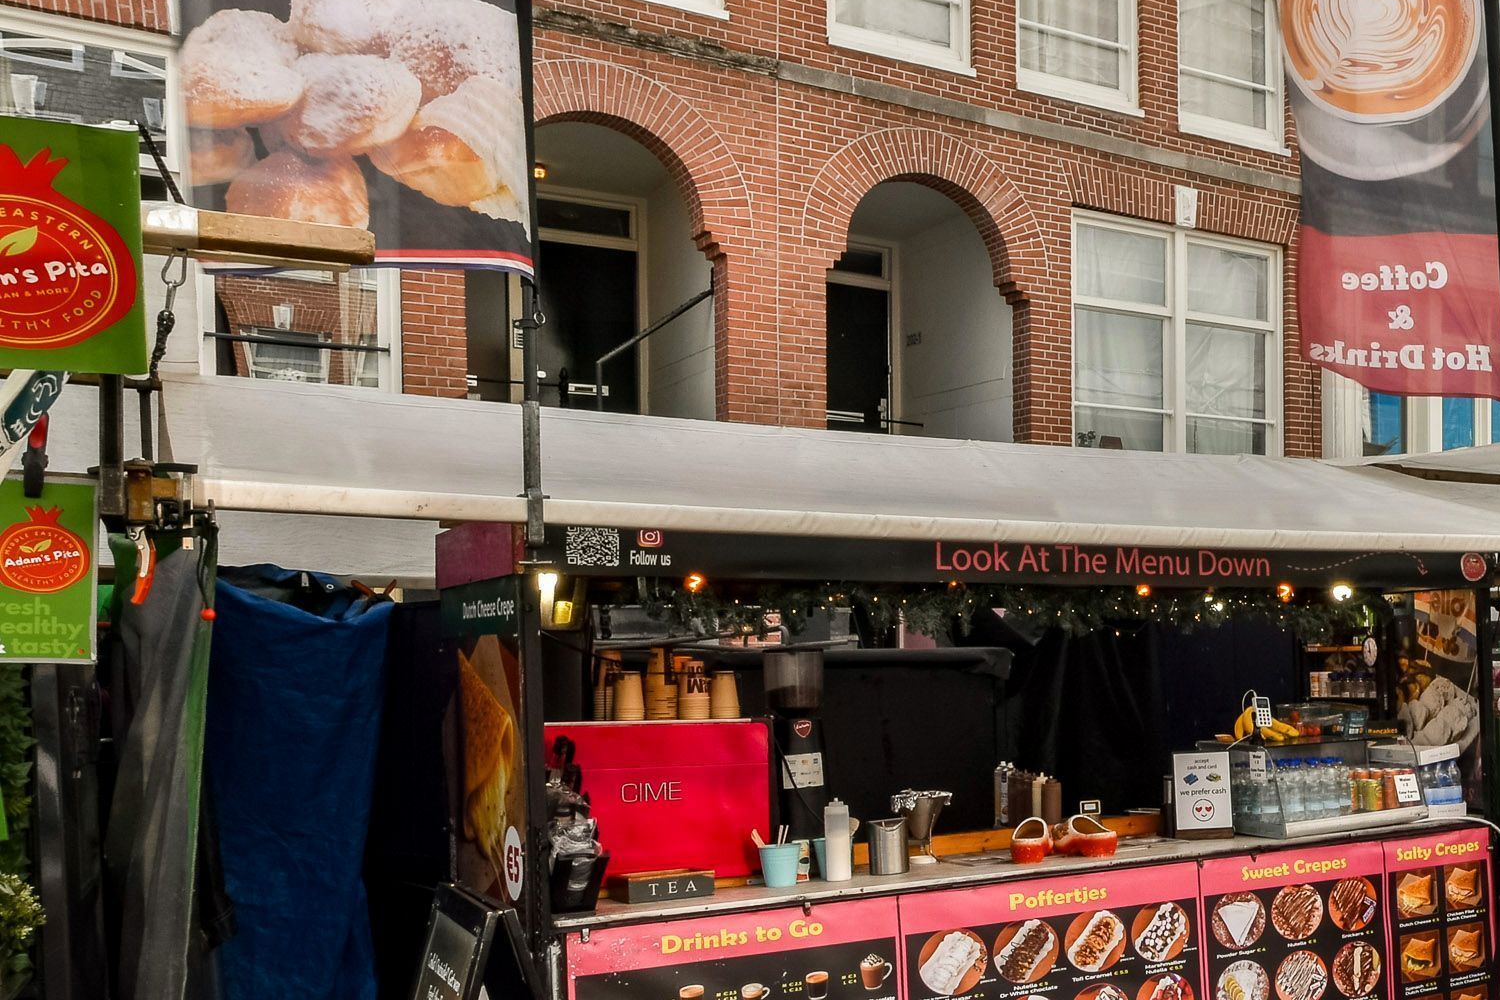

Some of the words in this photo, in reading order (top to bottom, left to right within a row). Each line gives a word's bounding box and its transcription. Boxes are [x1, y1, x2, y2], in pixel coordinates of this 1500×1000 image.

[44, 260, 108, 283] Pita
[4, 553, 51, 568] Adam's
[53, 549, 80, 563] Pita
[630, 550, 657, 567] Follow
[660, 554, 672, 567] us
[935, 541, 1010, 572] Look
[1018, 544, 1050, 573] At
[1055, 545, 1108, 574] The
[1115, 547, 1191, 576] Menu
[1199, 549, 1271, 577] Down
[477, 599, 497, 618] Cheese
[496, 596, 515, 621] Crepe
[621, 781, 683, 803] CIME
[1191, 788, 1210, 798] prefer
[1396, 844, 1431, 862] Salty
[1436, 840, 1480, 858] Crepes
[506, 844, 520, 884] €5
[1241, 862, 1290, 882] Sweet
[1294, 856, 1348, 876] Crepes
[1008, 885, 1108, 911] Poffertjes
[661, 928, 748, 954] Drinks
[755, 926, 782, 943] to
[788, 920, 823, 938] Go
[1287, 940, 1307, 948] Nutella
[1216, 951, 1239, 959] Powder
[1238, 948, 1256, 957] Sugar
[1085, 972, 1113, 981] Caramel
[1145, 966, 1168, 975] Nutella
[1009, 988, 1029, 997] White
[1013, 982, 1038, 991] Nutella
